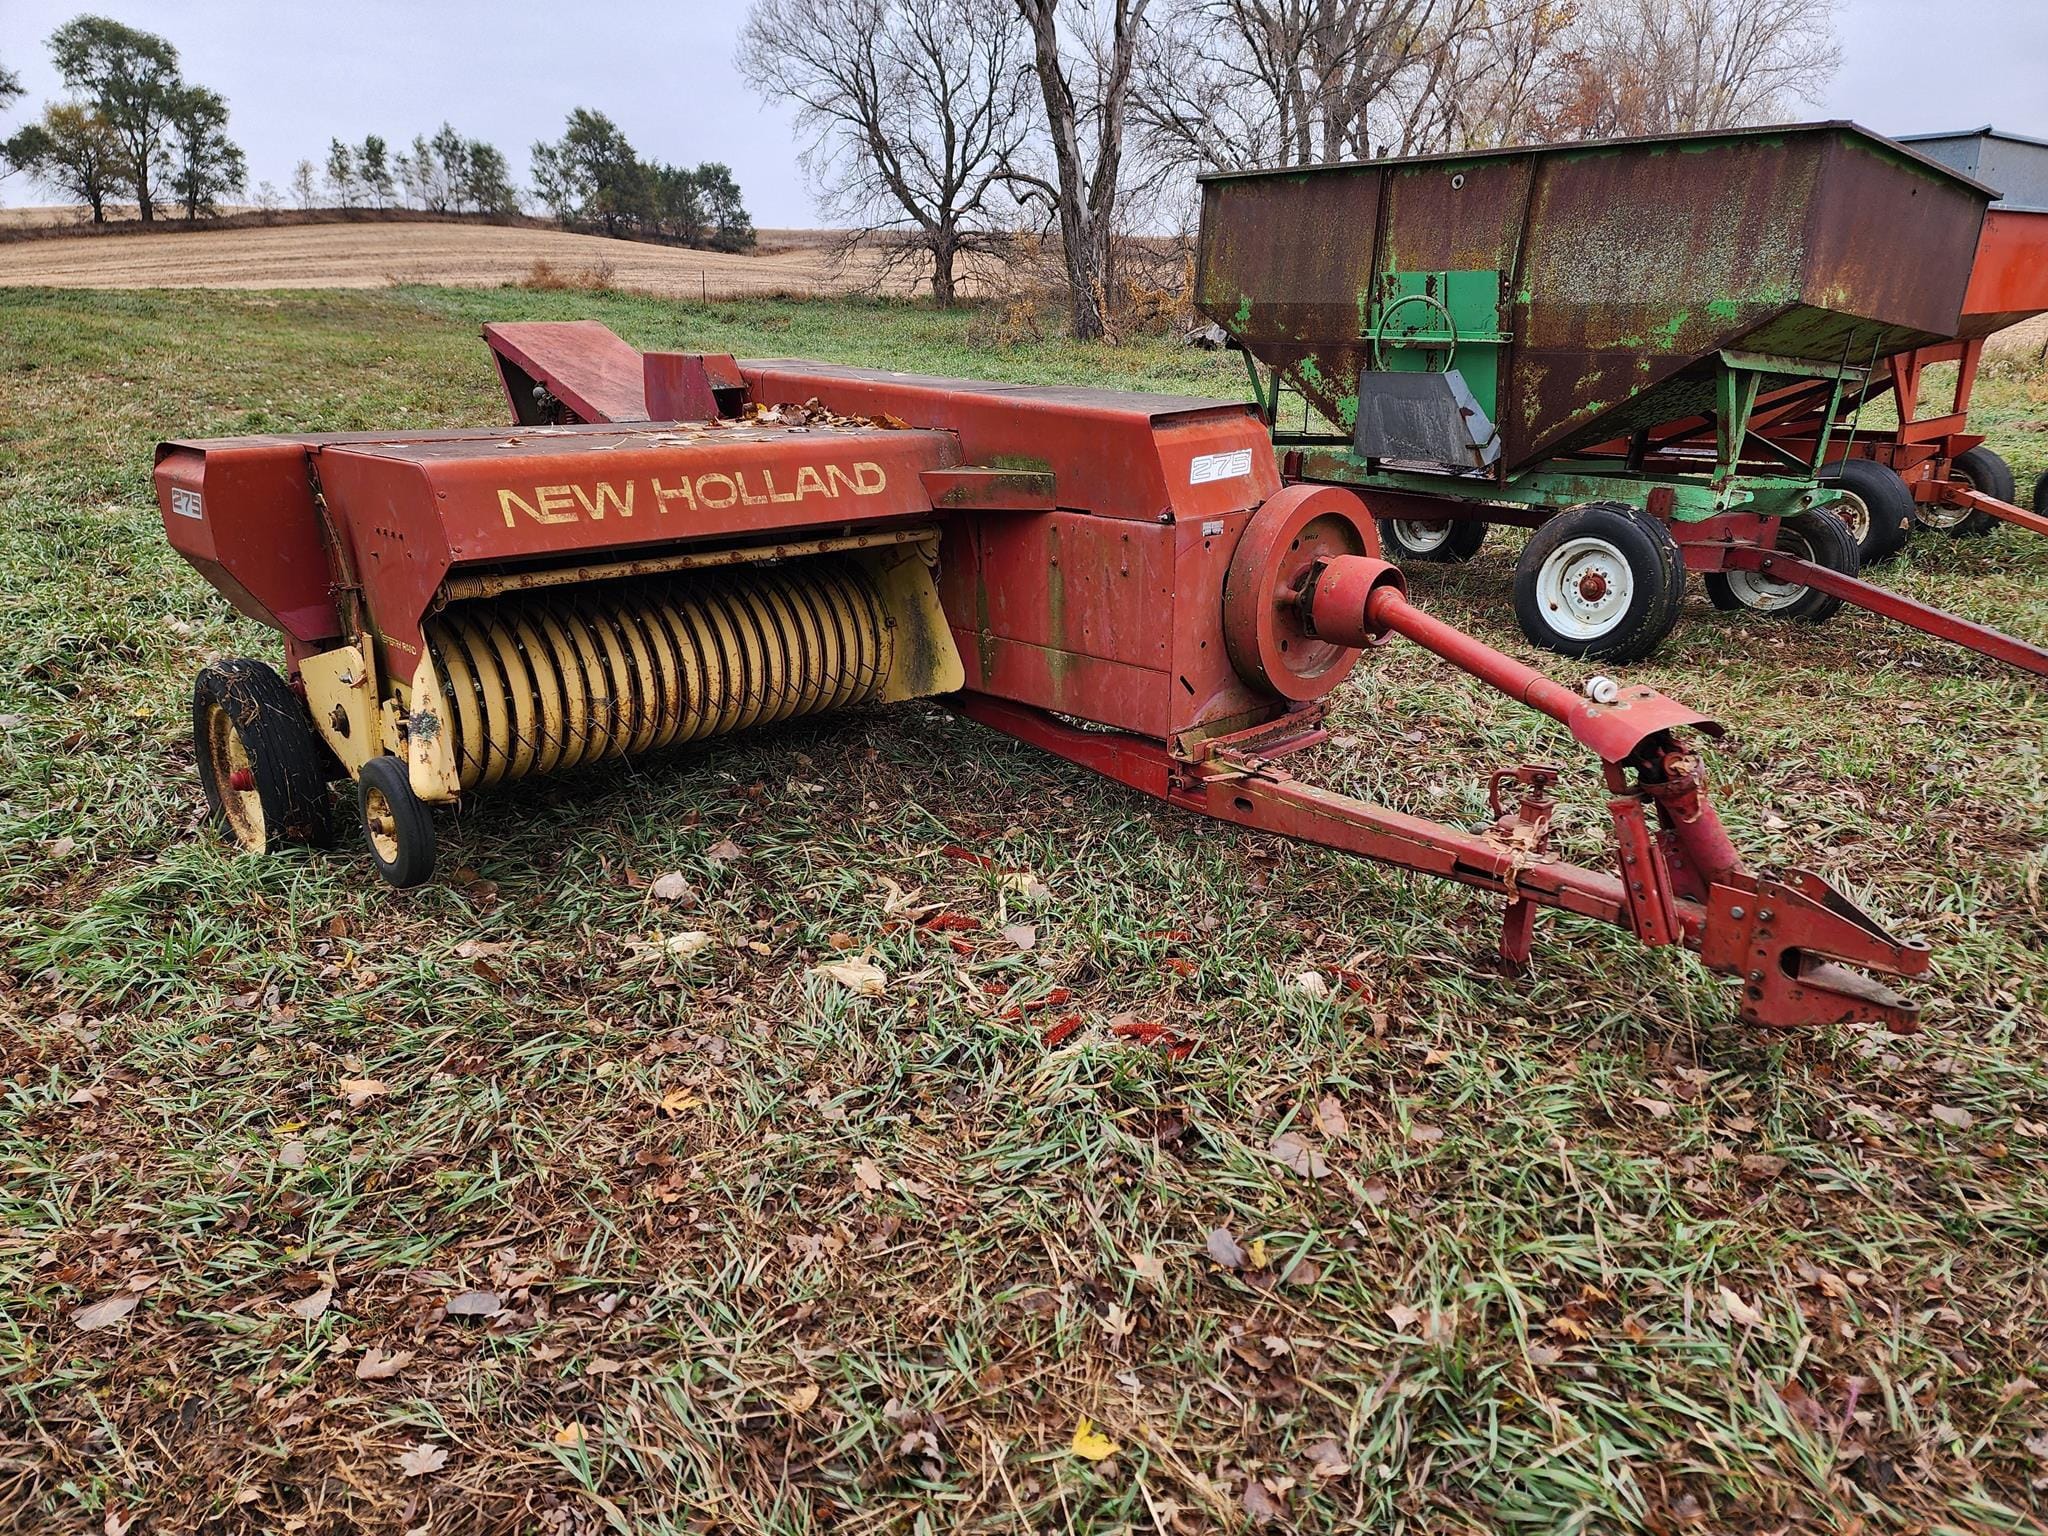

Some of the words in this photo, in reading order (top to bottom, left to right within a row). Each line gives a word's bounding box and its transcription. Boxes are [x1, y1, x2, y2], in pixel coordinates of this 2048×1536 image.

[1192, 451, 1250, 480] 275
[173, 489, 201, 516] 275
[497, 479, 635, 527] NEW
[651, 461, 887, 514] HOLLAND
